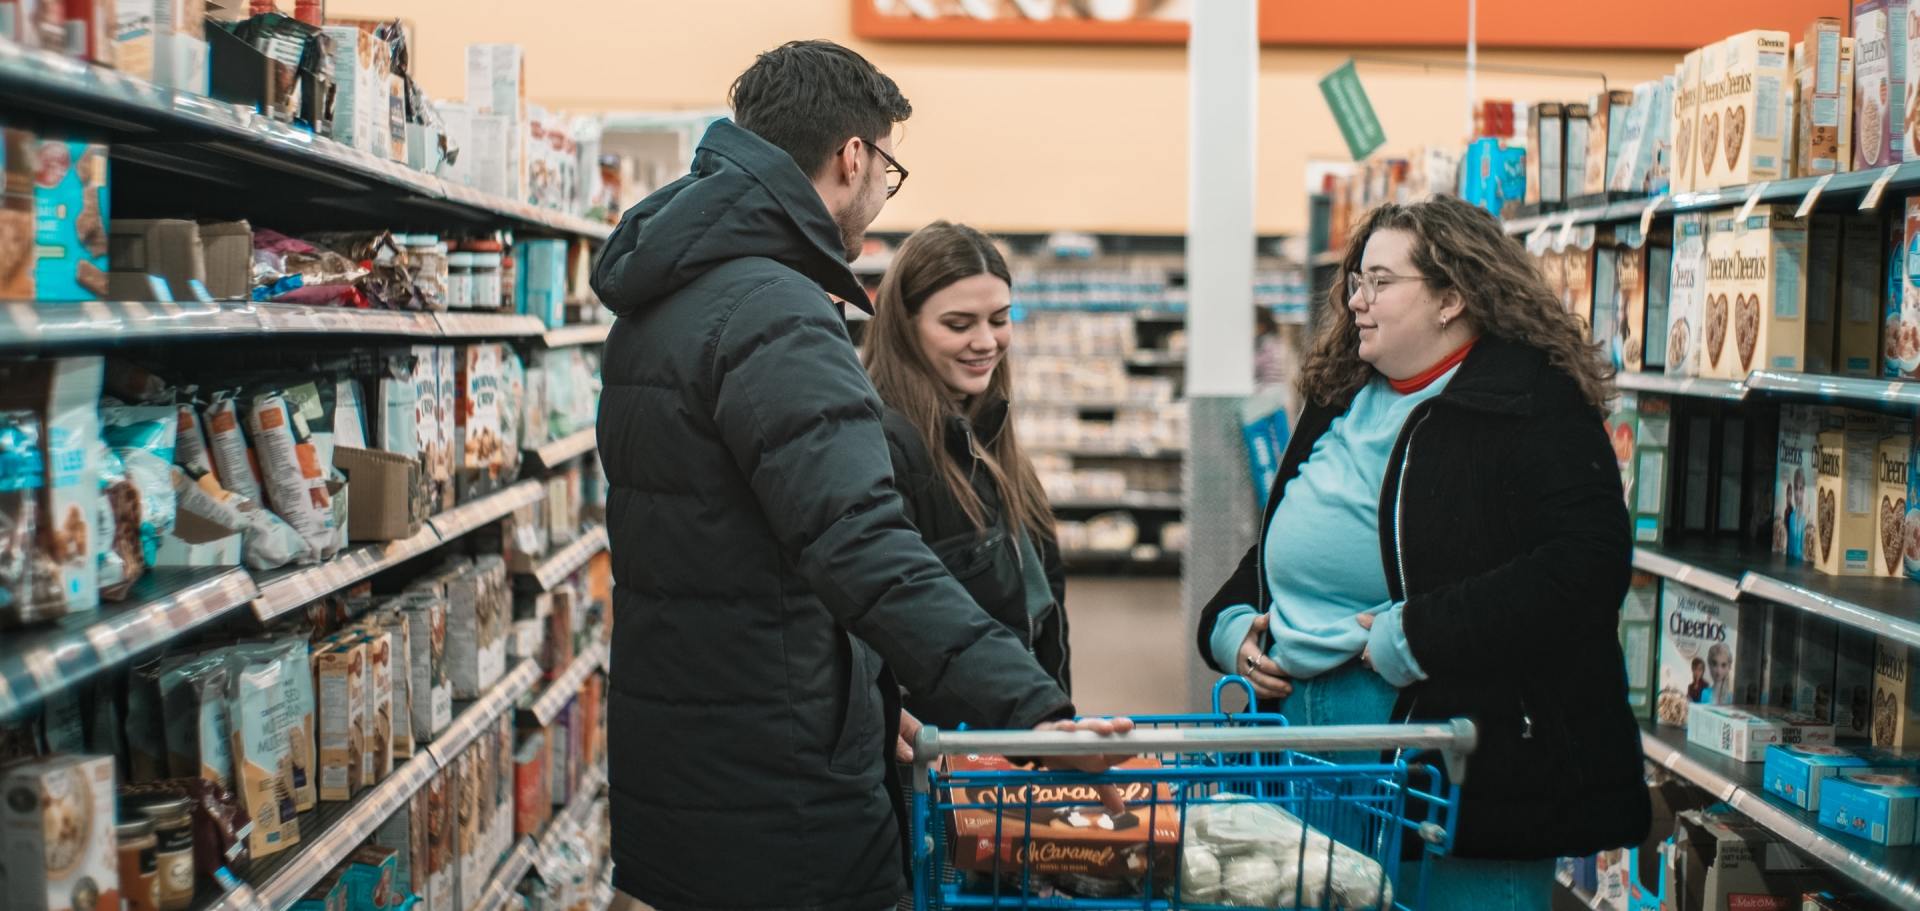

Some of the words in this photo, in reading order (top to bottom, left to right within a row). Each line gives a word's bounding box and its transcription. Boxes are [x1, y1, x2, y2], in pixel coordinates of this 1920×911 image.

[1757, 37, 1785, 48] Cheerios
[1726, 71, 1752, 100] Cheerios
[1733, 248, 1766, 281] Cheerios
[1669, 611, 1726, 643] Cheerios
[1017, 783, 1150, 803] Carael!
[1038, 842, 1115, 867] Caramel!
